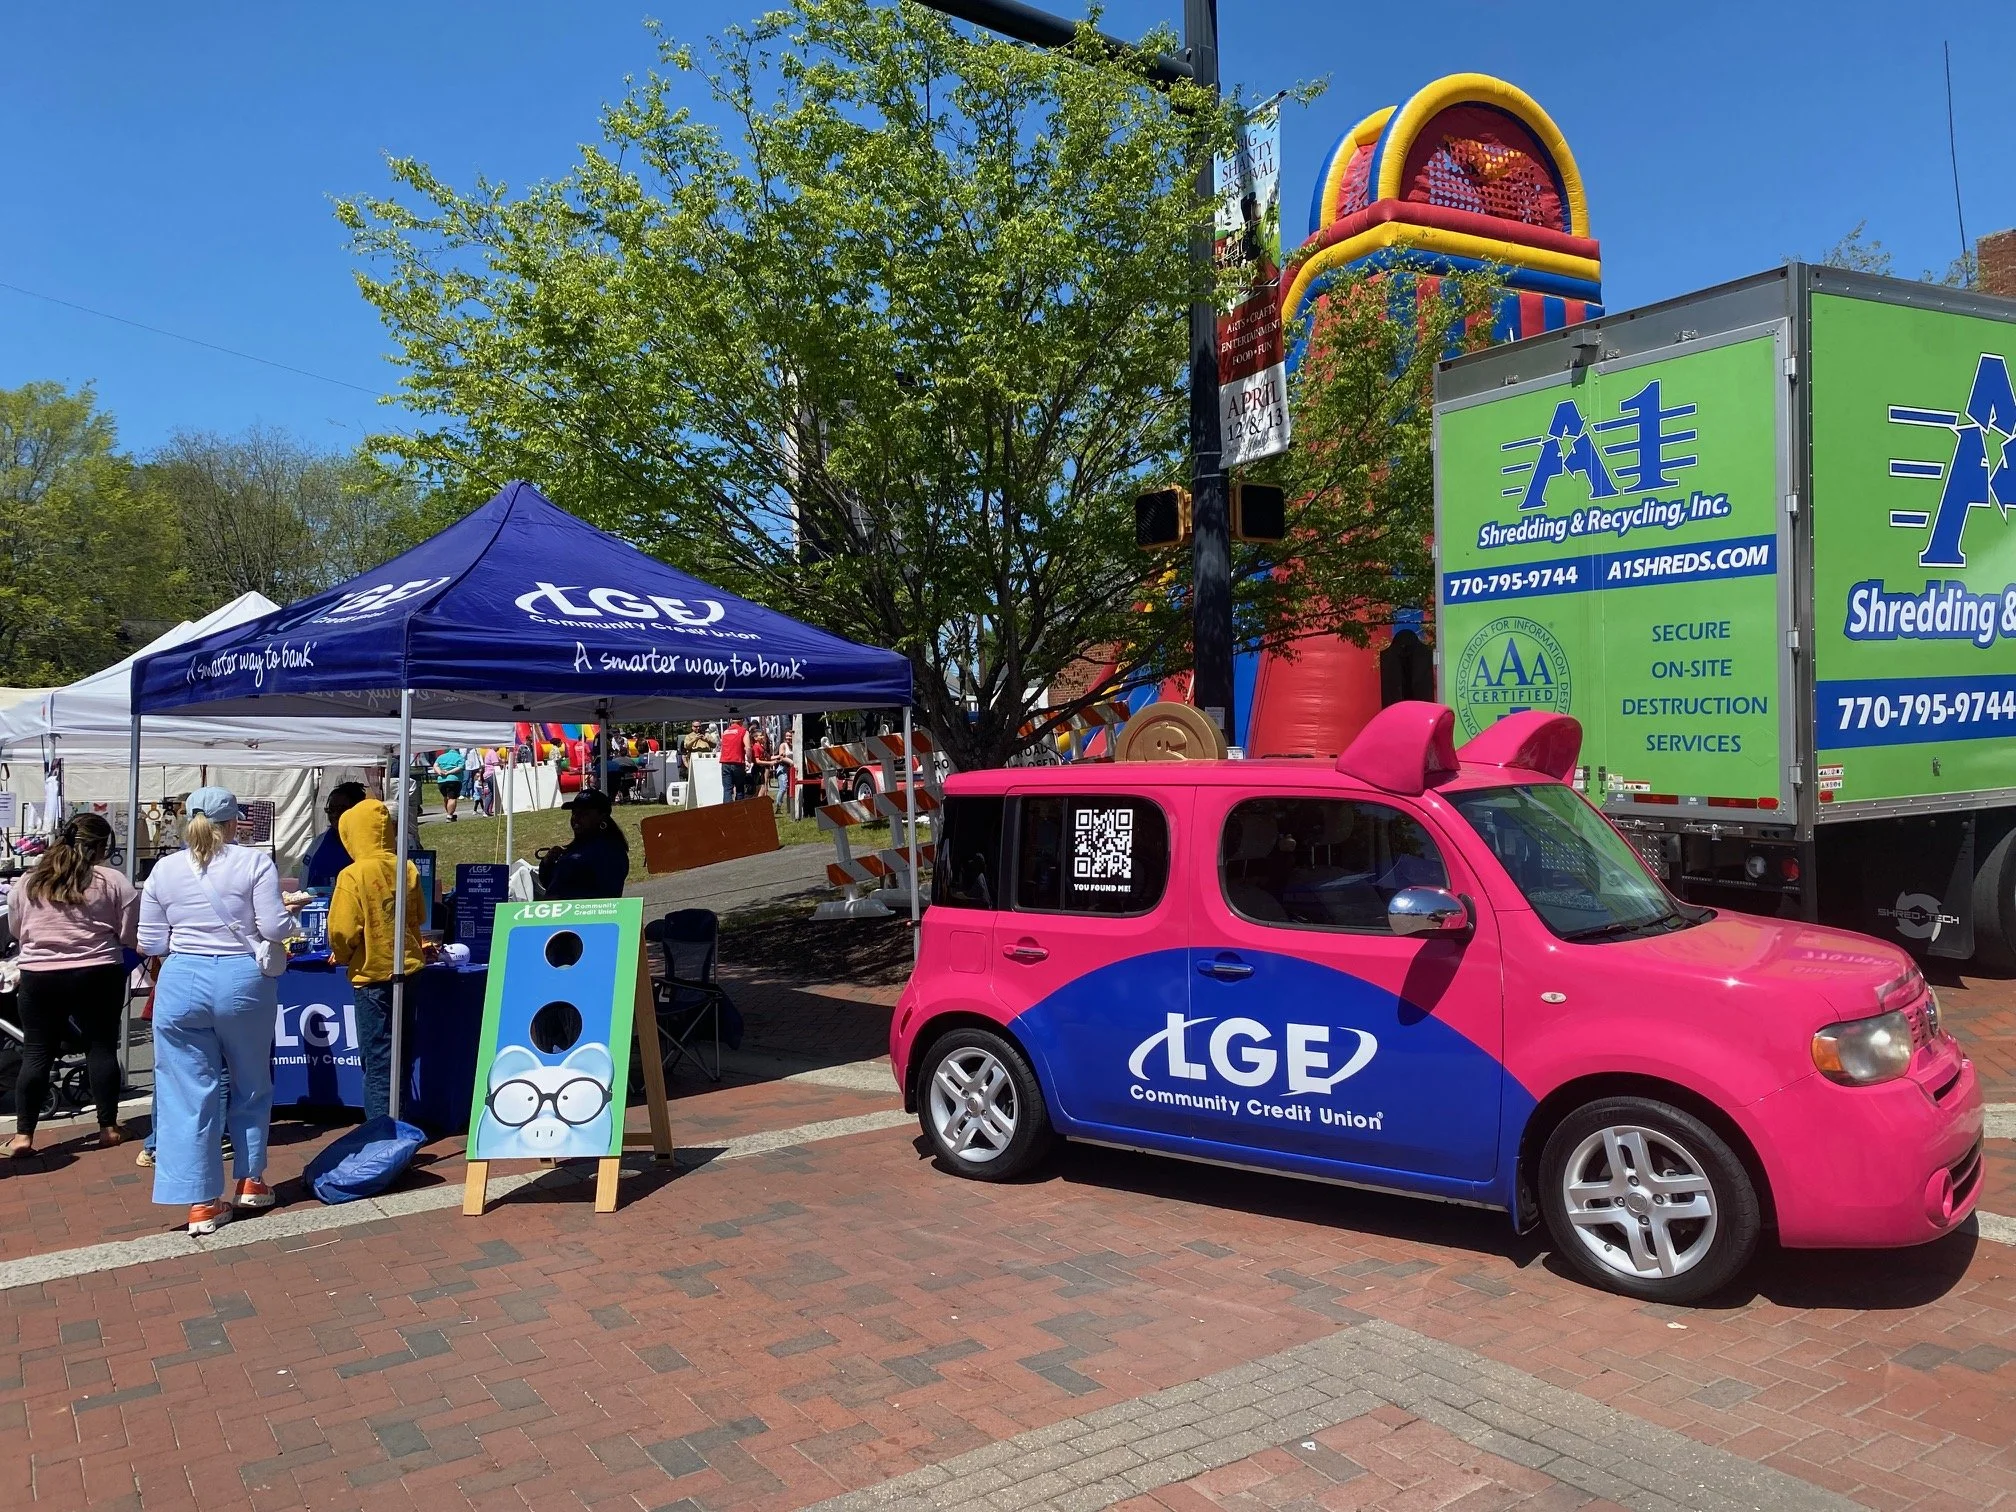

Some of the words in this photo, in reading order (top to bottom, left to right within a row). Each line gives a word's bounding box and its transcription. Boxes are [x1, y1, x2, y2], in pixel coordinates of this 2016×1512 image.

[1238, 129, 1257, 154] BIG
[1222, 138, 1274, 182] SHANTY
[1221, 318, 1281, 353] ENTERTAINMENT
[1226, 317, 1246, 334] ARTS
[1250, 302, 1277, 323] CRAFTS
[1232, 349, 1254, 365] FOOD
[1257, 340, 1273, 355] FUN
[1227, 381, 1281, 419] APRIL
[1227, 421, 1243, 441] 12
[1249, 416, 1262, 436] &
[1267, 408, 1283, 430] 13
[1479, 516, 1568, 547] Shredding
[1570, 513, 1585, 534] &
[1591, 501, 1686, 533] Recycling,
[1690, 494, 1729, 518] Inc.
[1607, 545, 1769, 580] A1SHREDS.COM
[1450, 566, 1579, 597] 770-795-9744
[525, 581, 718, 626] LGE
[1850, 587, 1996, 643] Shredding
[529, 614, 646, 630] Community
[651, 621, 708, 635] Credit
[1652, 621, 1731, 642] SECURE
[186, 655, 197, 684] A
[197, 649, 238, 680] smarter
[239, 652, 264, 687] way
[265, 643, 281, 670] to
[1458, 630, 1489, 699] ASSOCIATION
[1471, 637, 1554, 687] AAA
[1490, 620, 1509, 634] FOR
[1514, 619, 1567, 676] INFORMATION
[574, 641, 593, 673] A
[600, 647, 680, 674] smarter
[685, 658, 729, 692] way
[730, 652, 756, 676] to
[1652, 658, 1732, 679] ON-SITE
[1472, 690, 1554, 703] CERTIFIED
[1622, 697, 1768, 715] DESTRUCTION
[1838, 691, 2016, 730] 770-795-9744
[1646, 734, 1742, 753] SERVICES
[1073, 883, 1090, 891] YOU
[1090, 884, 1117, 892] FOUND
[1117, 884, 1131, 892] ME!
[519, 903, 567, 919] LGE
[322, 1054, 362, 1067] Credit
[1145, 1012, 1350, 1096] LGE
[1130, 1084, 1240, 1116] Community
[1246, 1099, 1312, 1122] Credit
